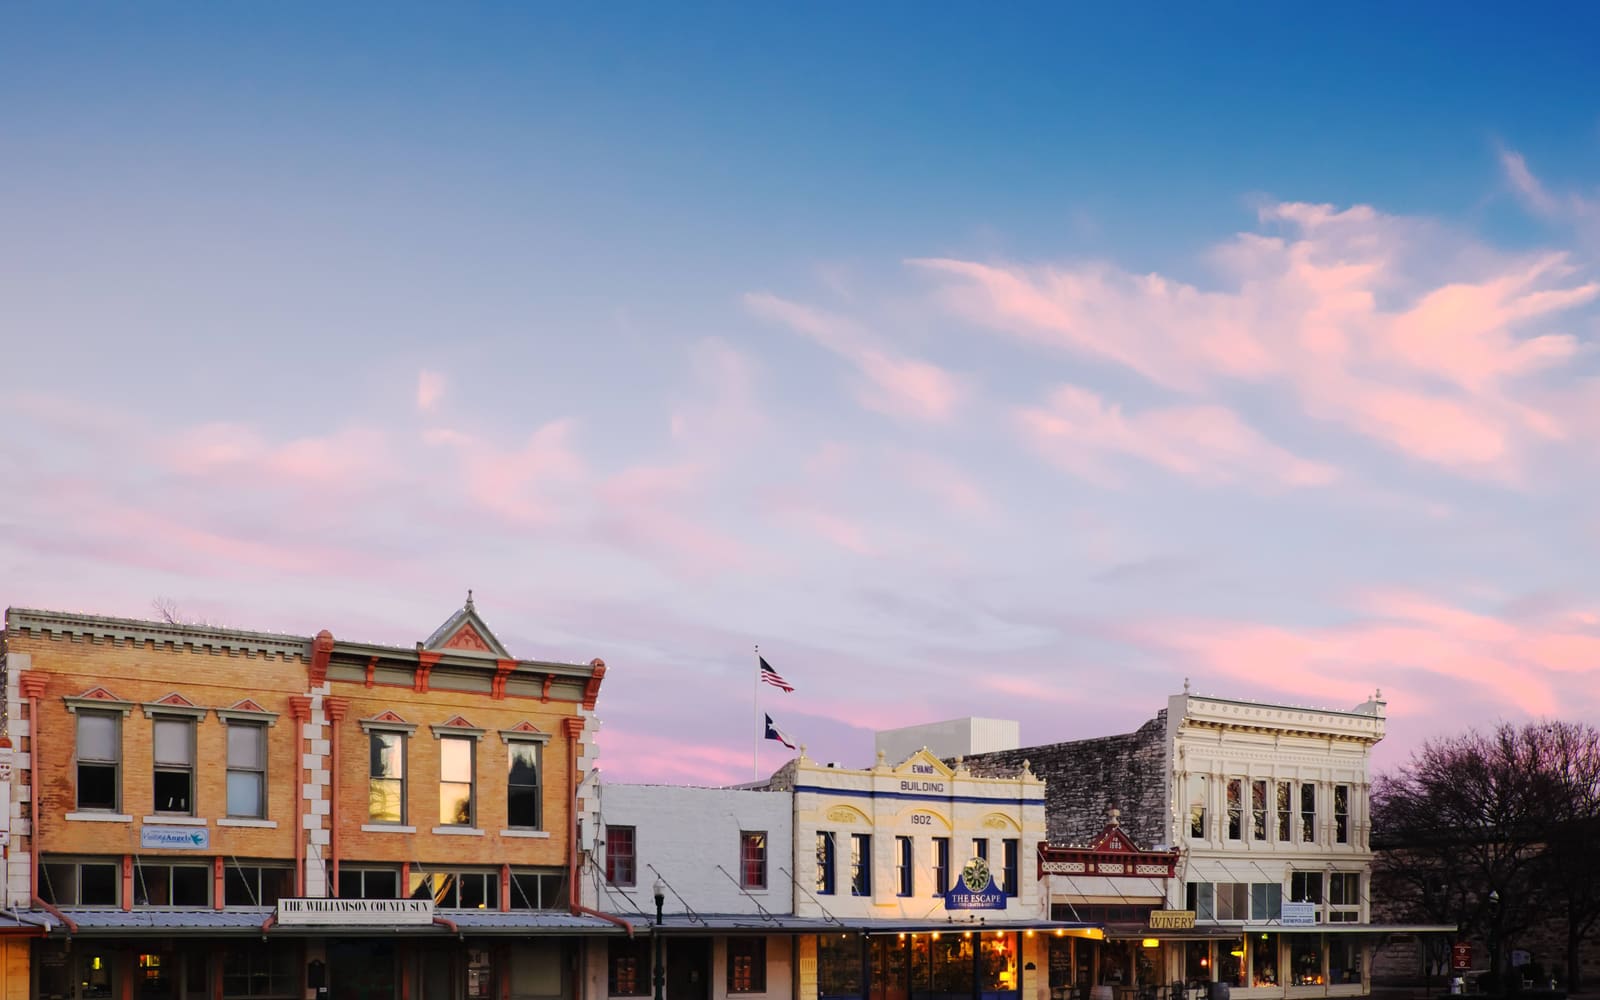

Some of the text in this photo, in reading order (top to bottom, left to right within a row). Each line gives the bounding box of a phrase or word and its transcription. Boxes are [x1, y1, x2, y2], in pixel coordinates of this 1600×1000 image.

[912, 764, 934, 774] EVANS
[900, 781, 944, 792] BUILDING
[911, 814, 932, 825] 1902
[952, 894, 1001, 903] THE ESCAPE
[284, 901, 428, 912] THE WILLIAMSON COUNTY SUN
[1151, 917, 1194, 928] WINERY
